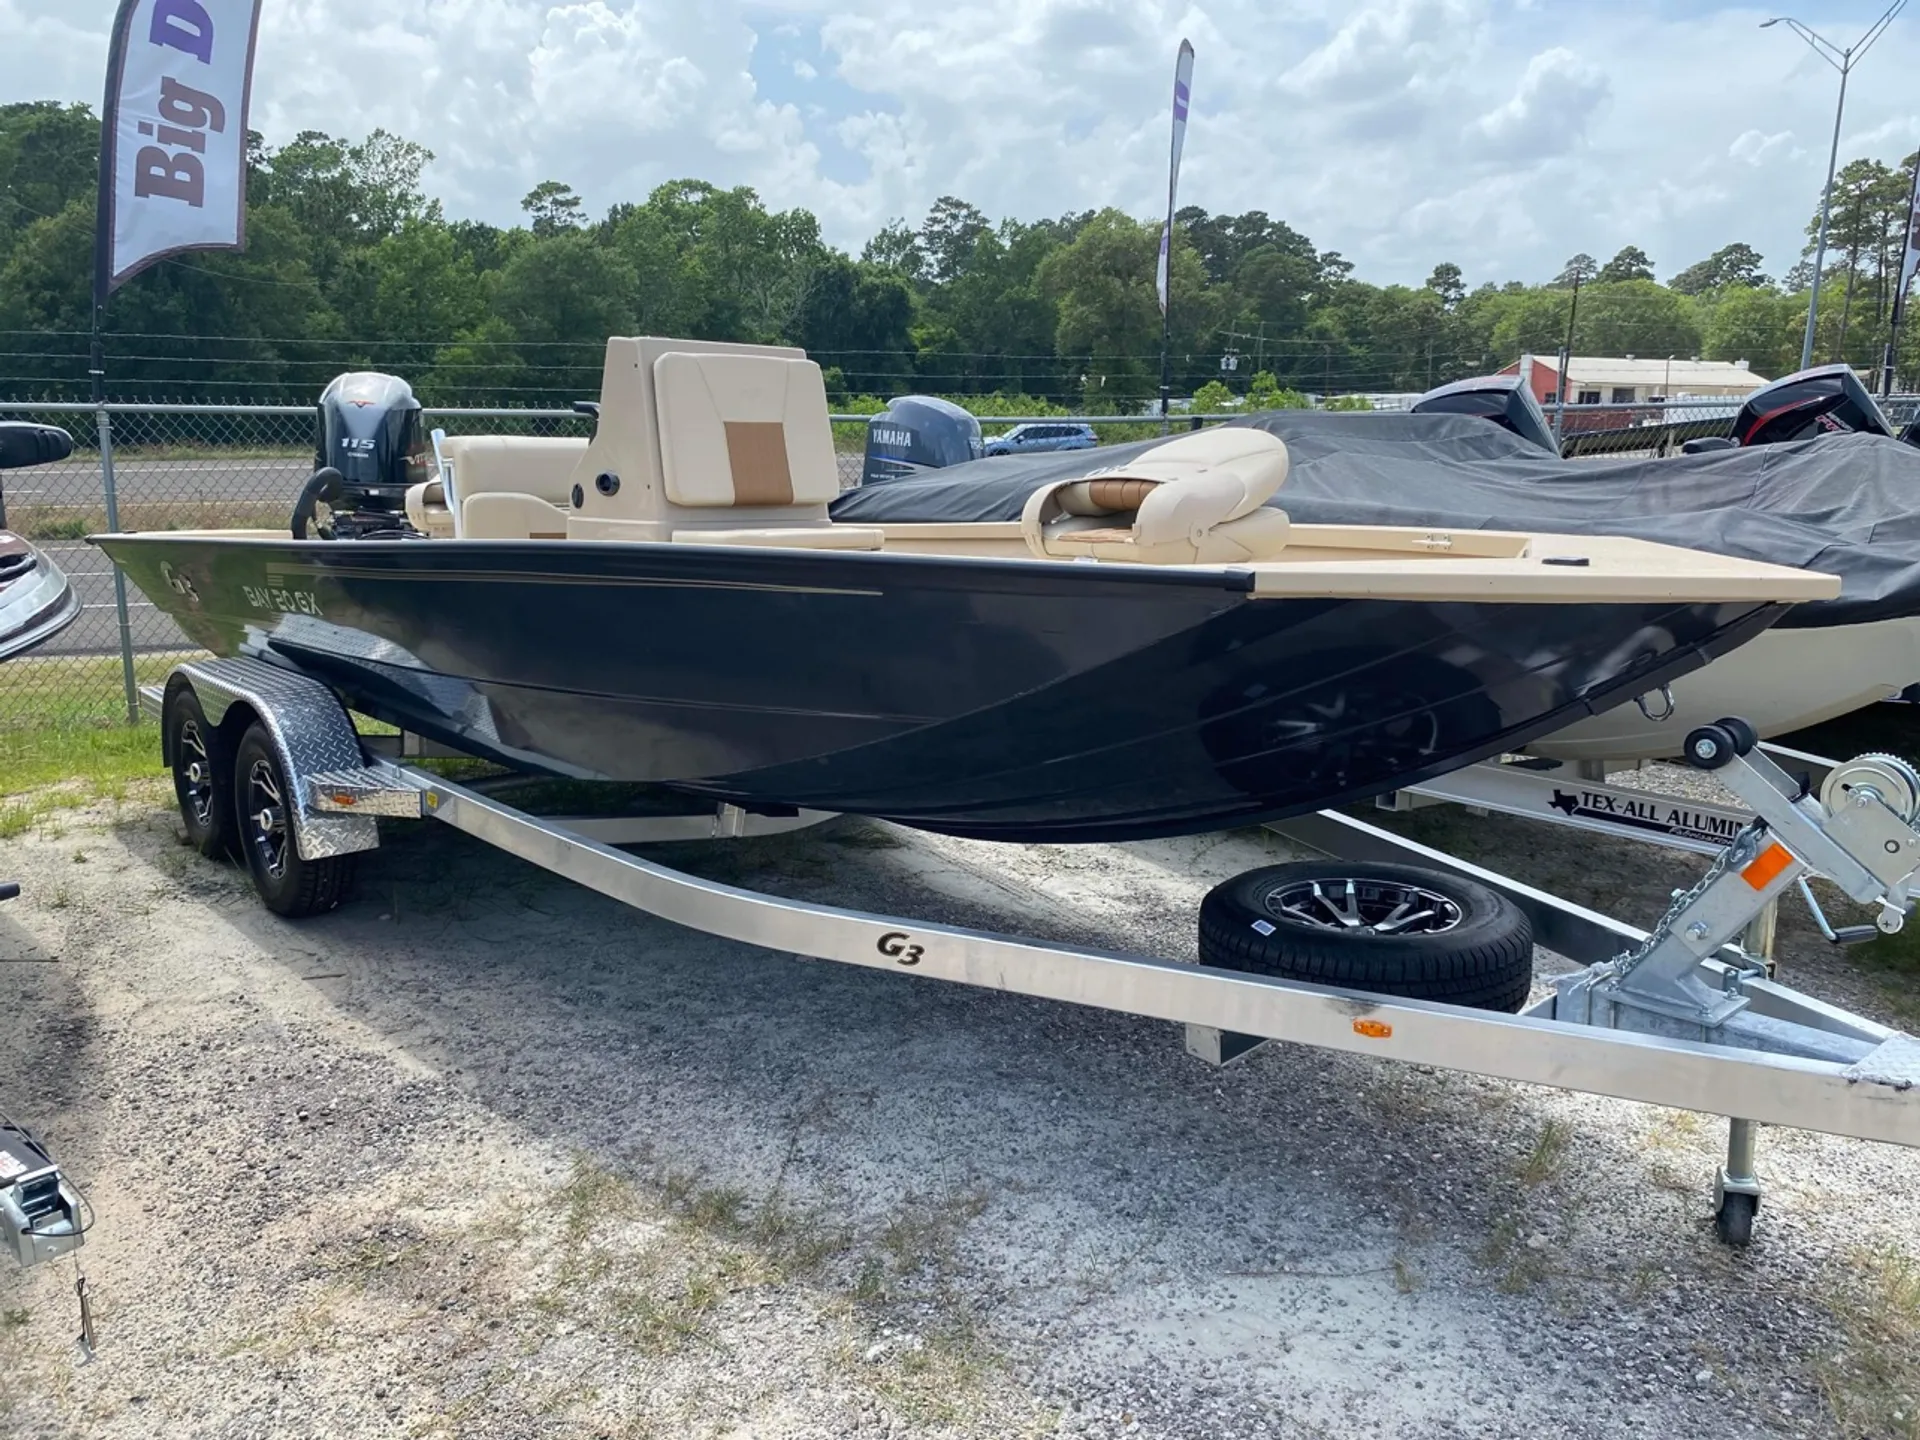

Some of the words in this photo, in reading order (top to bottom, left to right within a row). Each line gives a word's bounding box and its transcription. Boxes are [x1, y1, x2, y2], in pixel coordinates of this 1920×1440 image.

[134, 75, 225, 208] Big
[341, 437, 376, 450] 115
[872, 428, 912, 447] YAMAHA
[242, 585, 273, 609] BAY
[294, 591, 324, 616] GX
[1581, 791, 1660, 822] TEX-ALL
[876, 931, 925, 966] G3
